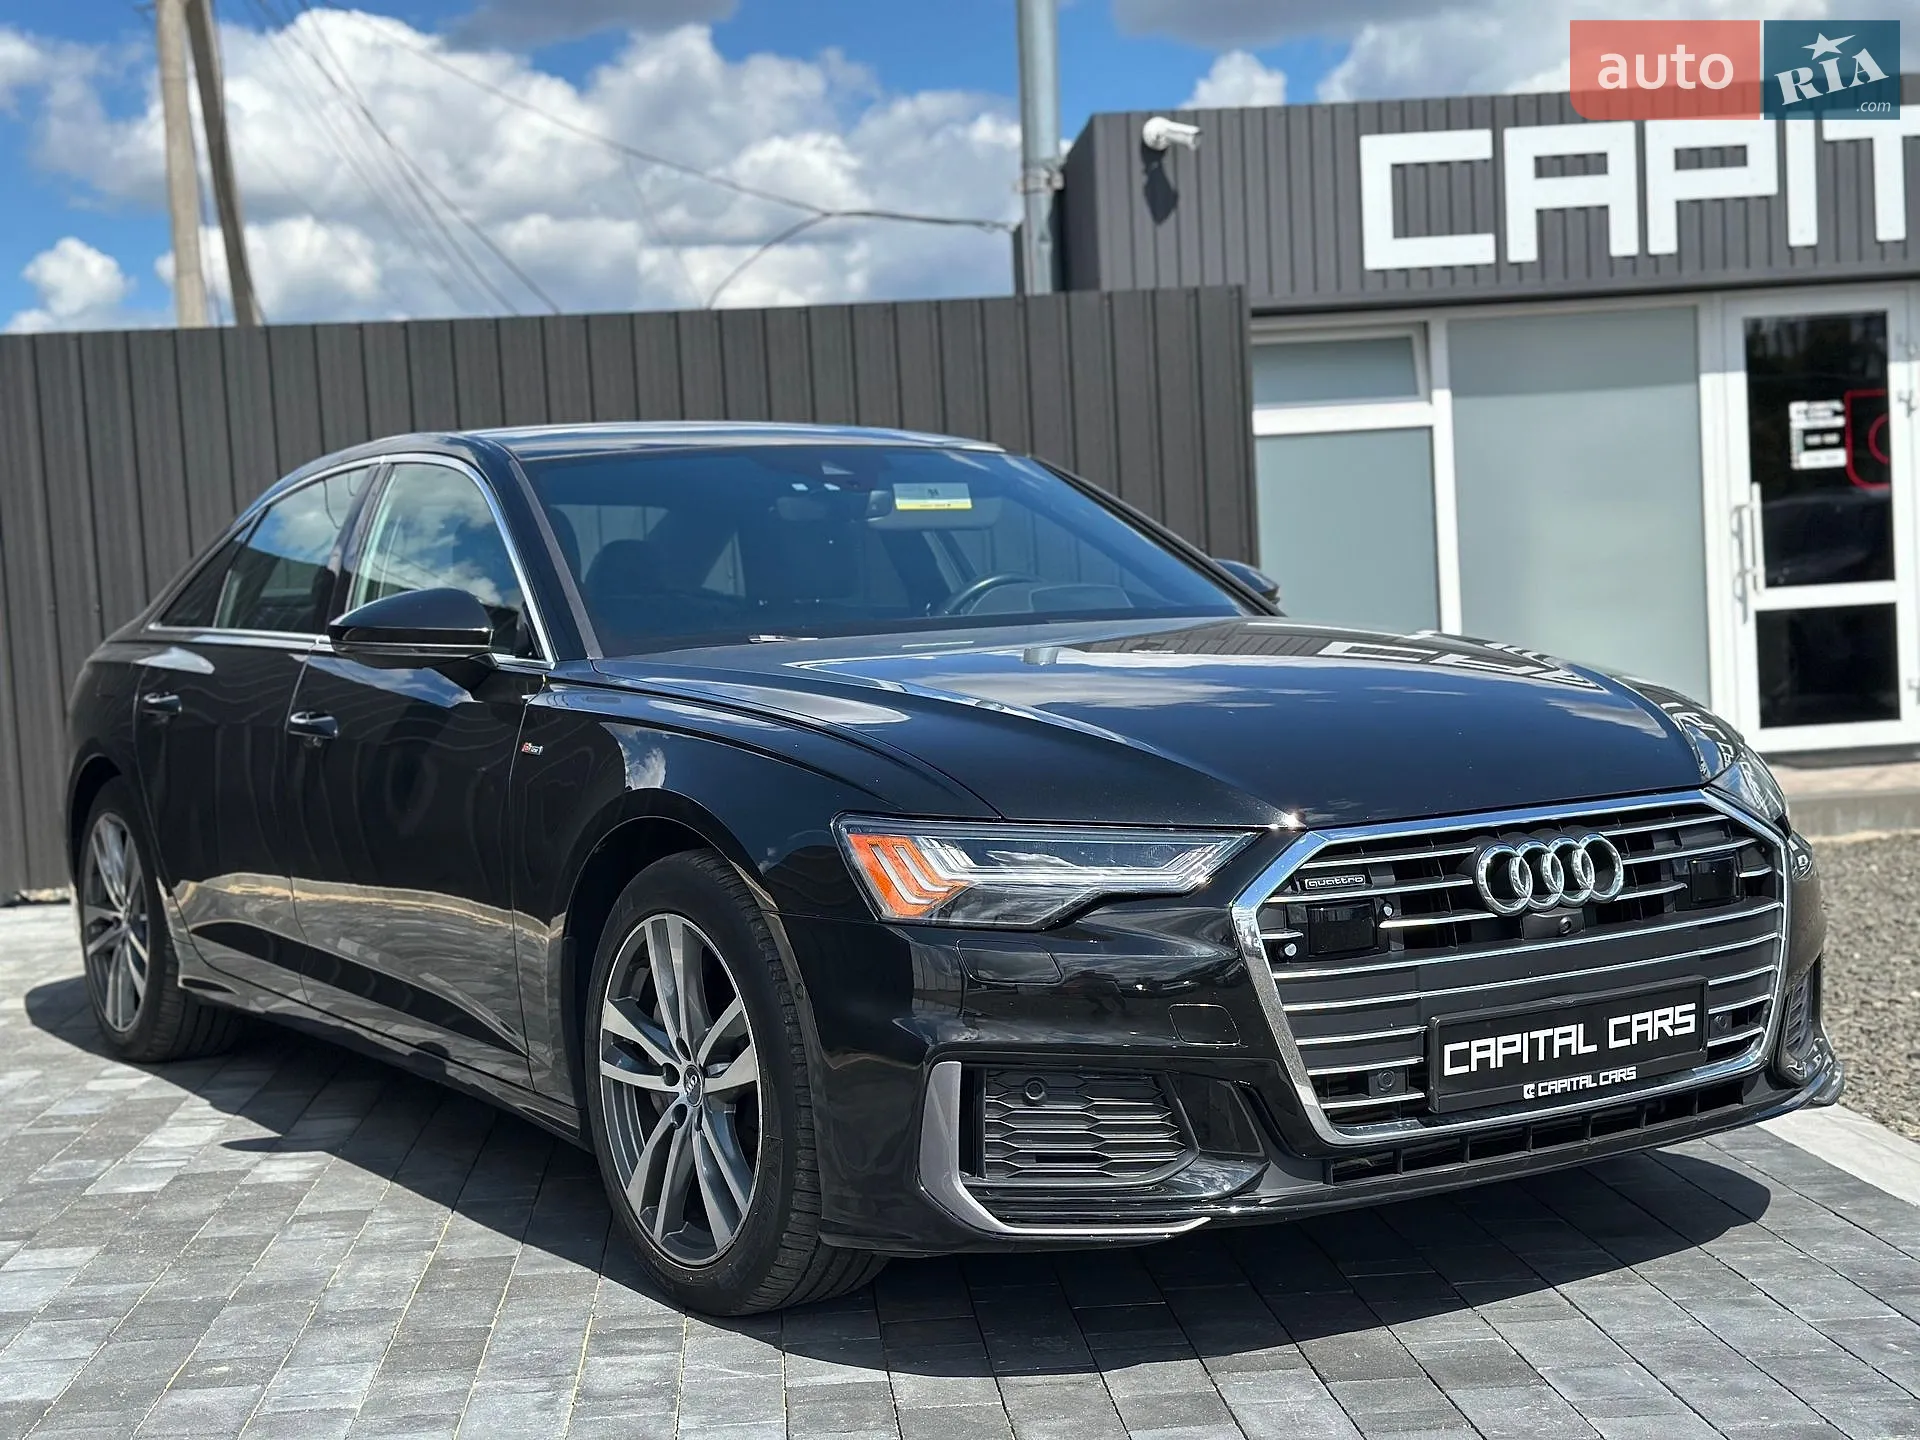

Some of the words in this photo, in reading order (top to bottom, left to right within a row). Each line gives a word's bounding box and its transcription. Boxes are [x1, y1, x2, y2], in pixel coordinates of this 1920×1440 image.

[1360, 104, 1920, 271] CAPIT
[1308, 875, 1364, 888] quattro
[1443, 1023, 1598, 1076] CAPITAL
[1608, 1002, 1696, 1049] CARS
[1538, 1074, 1598, 1096] CAPITAL
[1599, 1066, 1637, 1086] CARS
